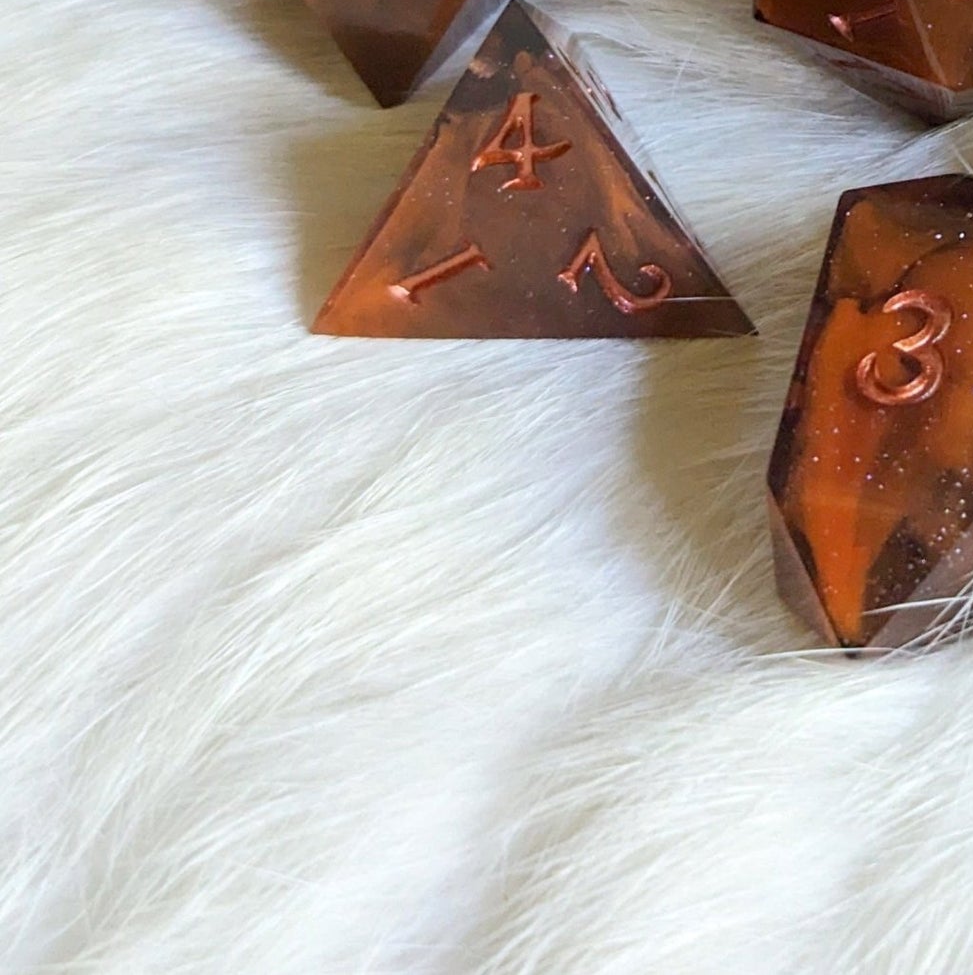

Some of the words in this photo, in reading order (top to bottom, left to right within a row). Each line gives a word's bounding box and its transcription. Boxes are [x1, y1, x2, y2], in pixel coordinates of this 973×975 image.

[471, 92, 573, 193] 4
[387, 240, 493, 308] 1
[557, 228, 673, 314] 2
[856, 288, 954, 406] 3
